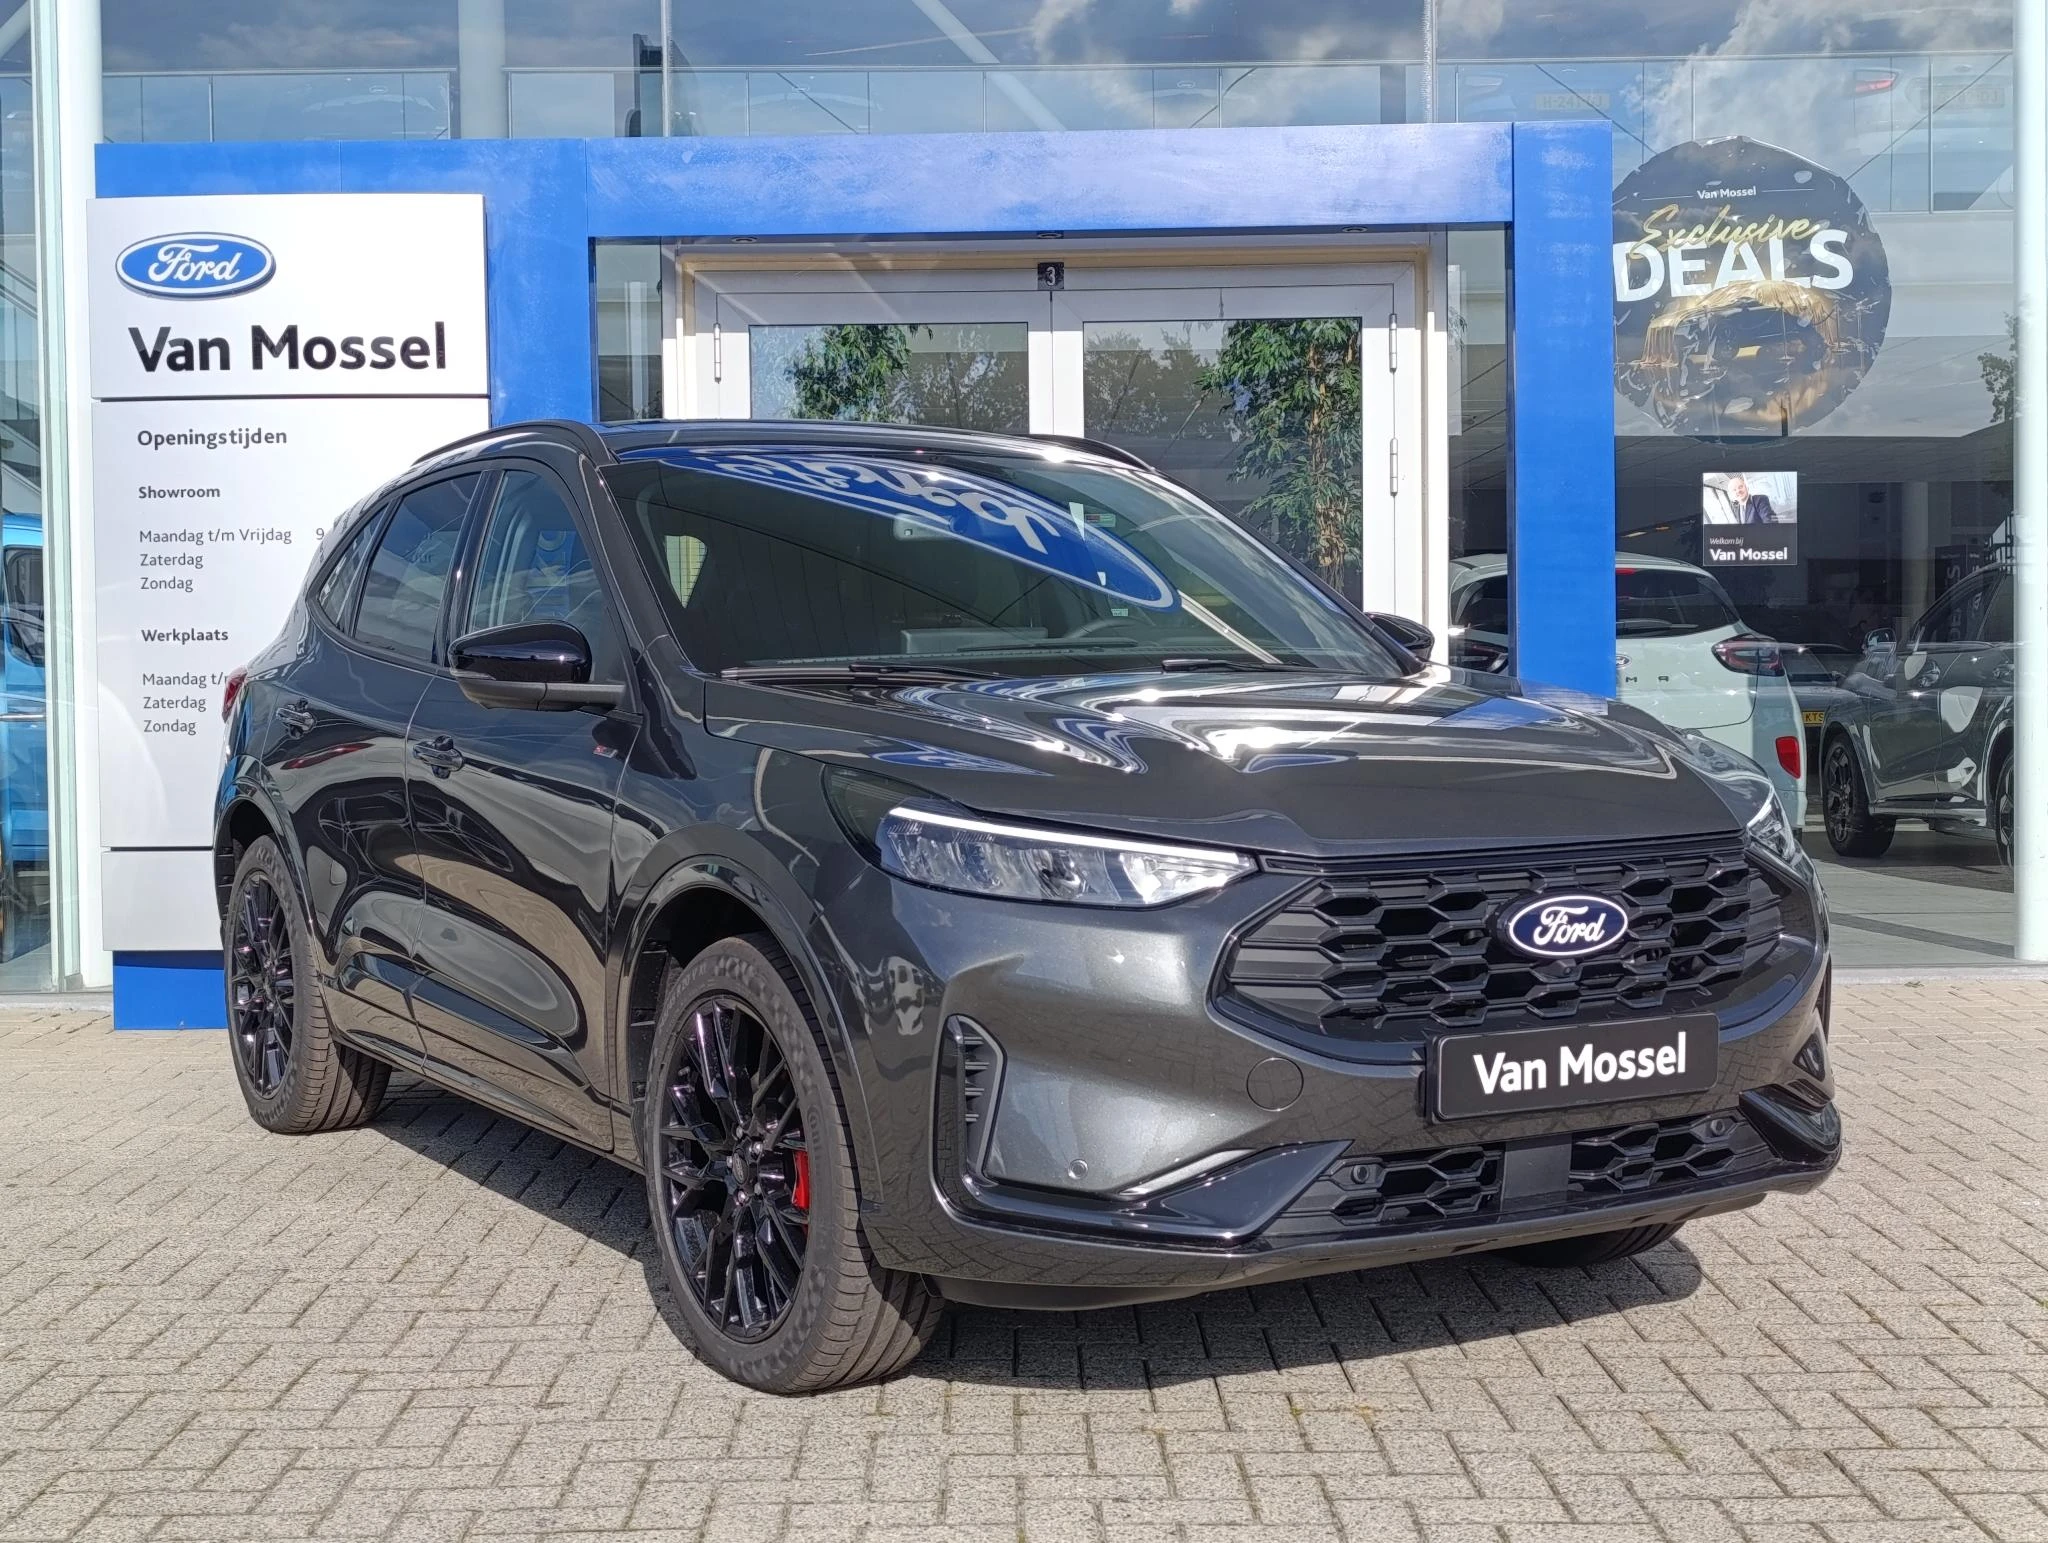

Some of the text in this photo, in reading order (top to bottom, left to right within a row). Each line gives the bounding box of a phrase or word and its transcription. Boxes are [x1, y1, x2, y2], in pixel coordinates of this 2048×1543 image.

[1697, 186, 1757, 199] Van Mossel
[1629, 204, 1823, 260] Exclusive
[147, 242, 244, 283] Ford
[1612, 229, 1854, 302] DEALS
[1046, 266, 1056, 286] 3
[128, 321, 446, 373] Van Mossel
[137, 427, 288, 451] Openingstijden
[138, 486, 221, 499] Showroom
[139, 529, 204, 546] Maandag
[207, 528, 235, 543] t/m
[239, 528, 293, 545] Vrijdag
[139, 552, 204, 568] Zaterdag
[1709, 547, 1788, 561] Van Mossel
[140, 576, 194, 593] Zondag
[141, 628, 229, 645] Werkplaats
[142, 671, 227, 689] Maandag t/
[143, 695, 207, 711] Zaterdag
[143, 718, 197, 736] Zondag
[1533, 904, 1607, 946] Ford
[1473, 1031, 1687, 1095] Van Mossel
